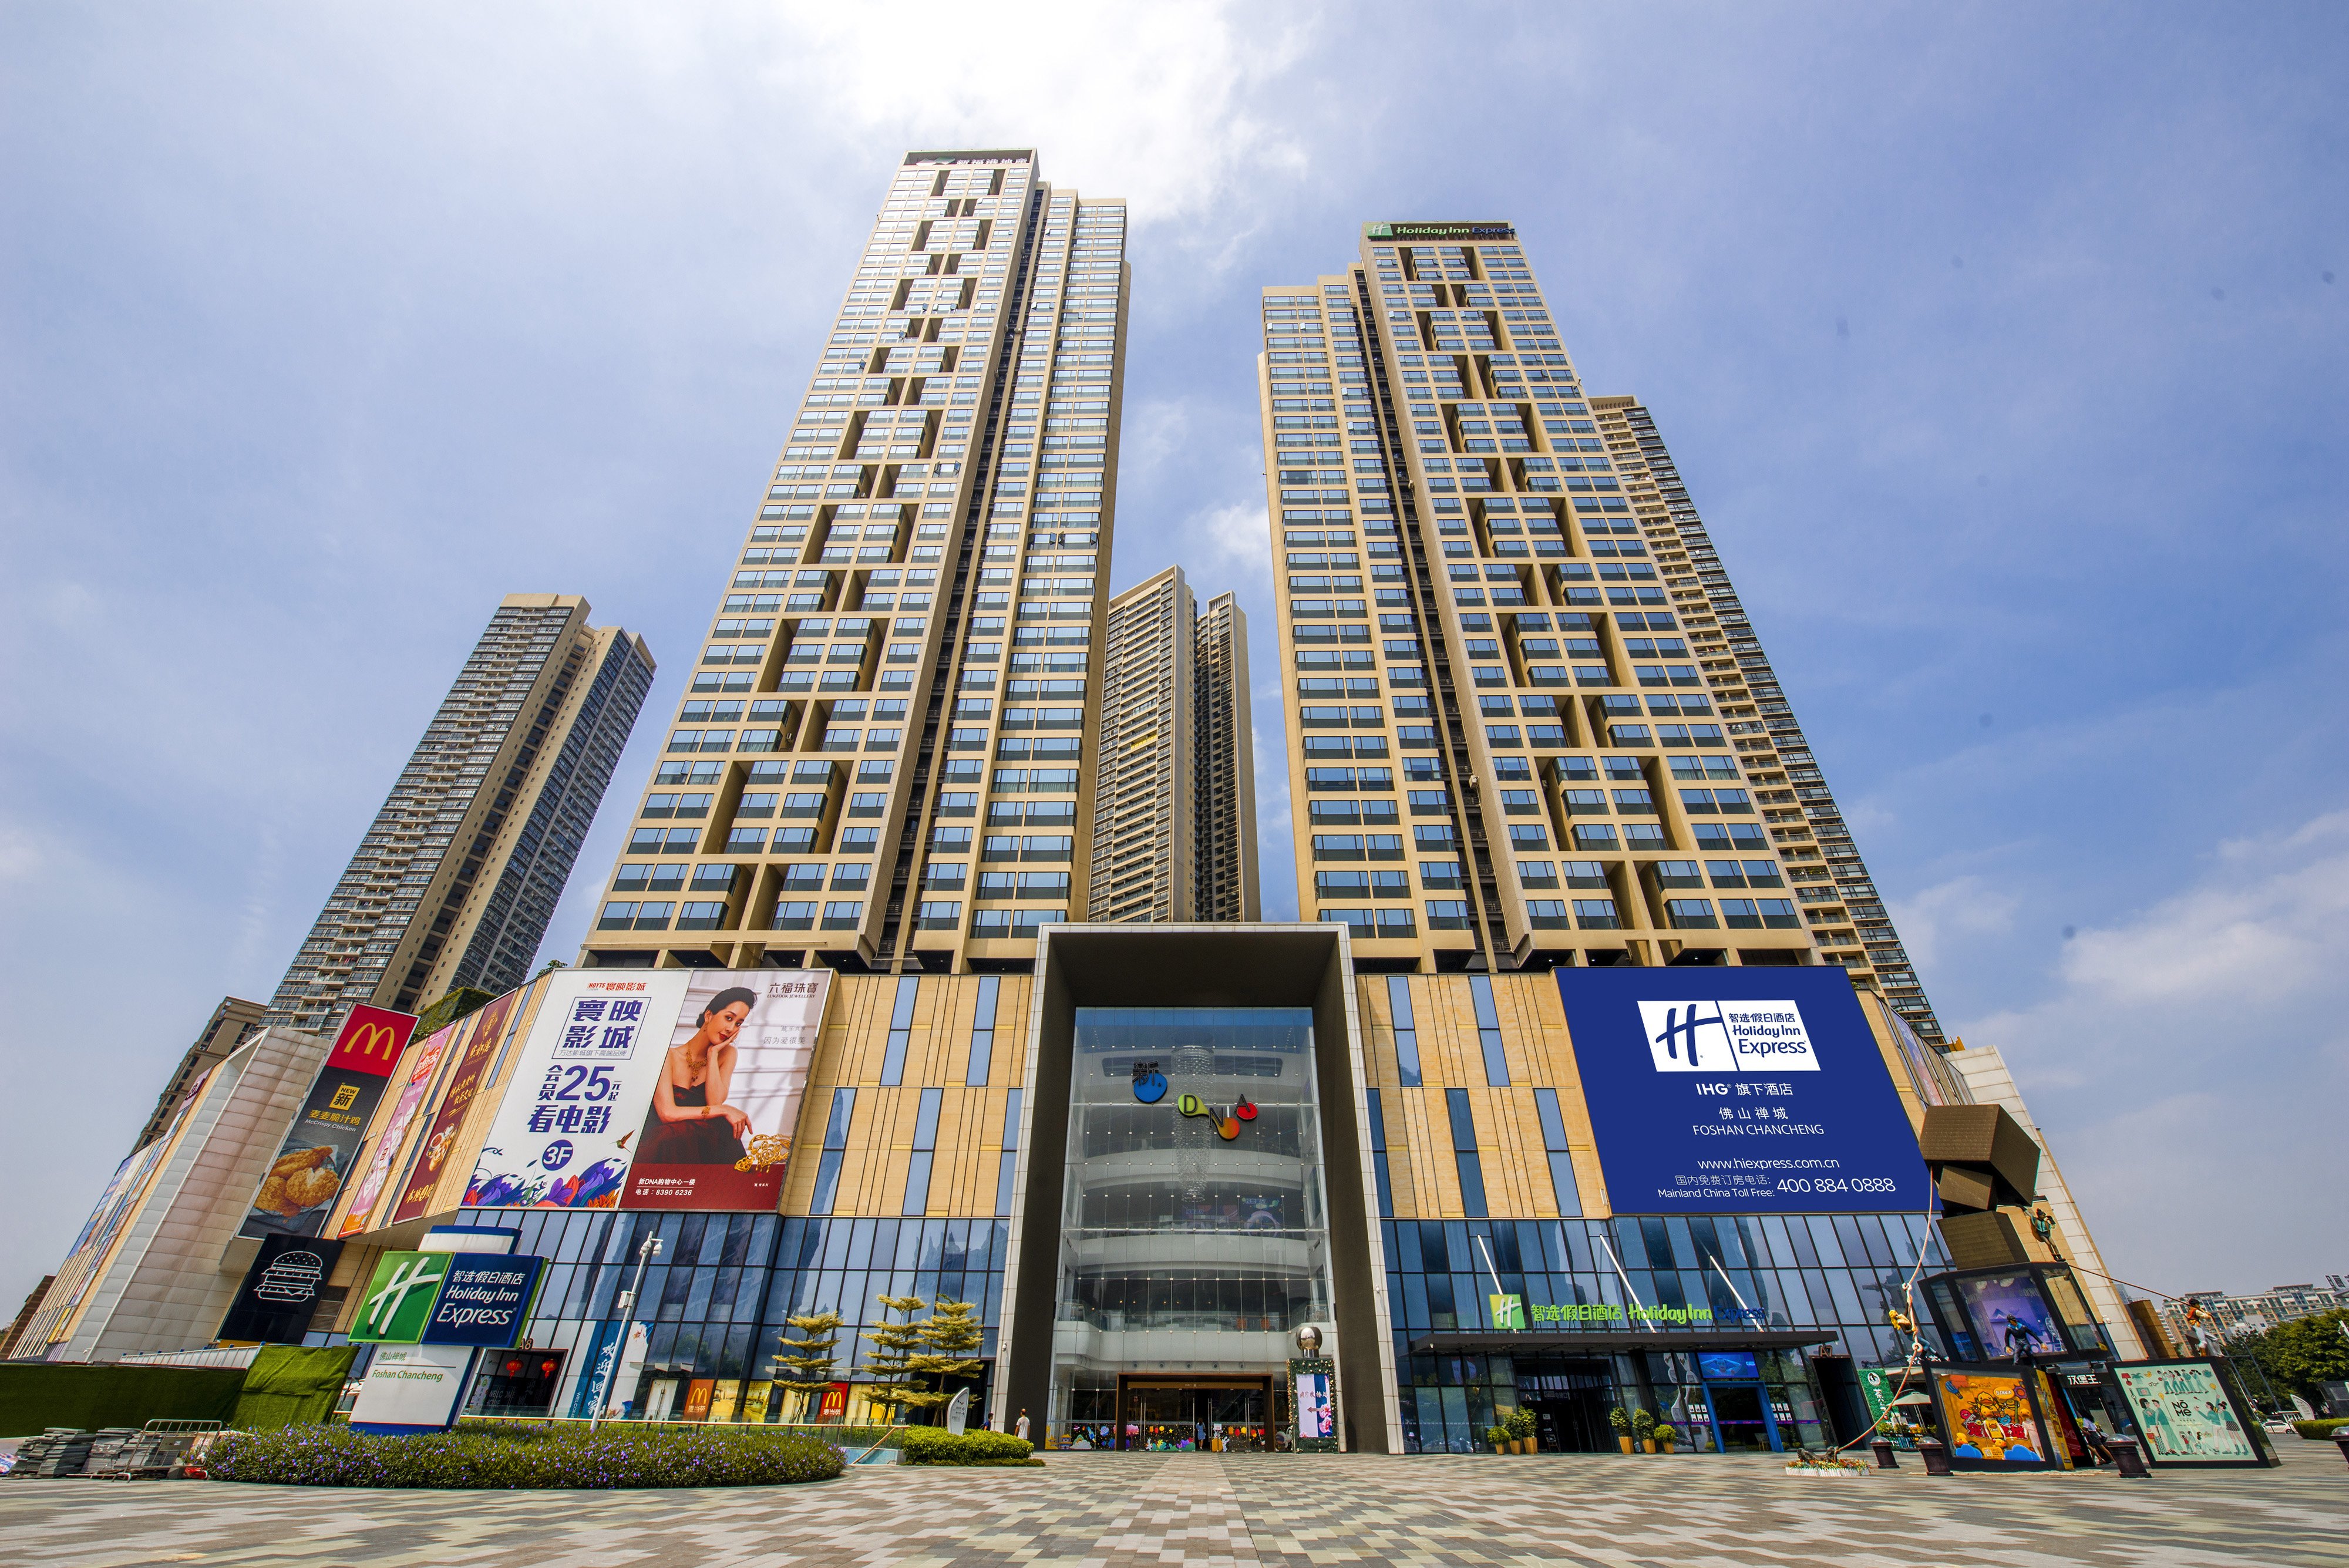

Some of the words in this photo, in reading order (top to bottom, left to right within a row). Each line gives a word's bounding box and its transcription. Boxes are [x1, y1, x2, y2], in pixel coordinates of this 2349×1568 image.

[1396, 227, 1447, 235] Holiday
[769, 982, 819, 994] 六福珠寶
[1728, 1012, 1796, 1024] 智选假日酒店
[562, 1025, 635, 1048] 影城
[1732, 1024, 1781, 1038] Holiday
[1782, 1025, 1801, 1035] Inn
[763, 1036, 806, 1045] 因为爱很美
[1738, 1038, 1808, 1058] Express
[1132, 1059, 1159, 1086] 新
[555, 1065, 615, 1101] 25
[1696, 1084, 1728, 1096] IHG
[1735, 1083, 1793, 1096] 旗下酒店
[332, 1093, 354, 1107] 新
[308, 1109, 361, 1126] 麦麦脆汁鸡
[527, 1105, 613, 1133] 看电影
[1718, 1107, 1788, 1121] 佛山禅城
[305, 1119, 332, 1128] McCrispy
[332, 1123, 356, 1132] Chicken
[1692, 1125, 1744, 1136] FOSHAN
[1746, 1124, 1825, 1135] CHANCHENG
[543, 1146, 574, 1165] 3F
[1697, 1158, 1840, 1172] www.hiexpress.com.cn
[638, 1177, 696, 1186] 新DNA购物中心一楼
[1777, 1178, 1810, 1193] 400
[1814, 1178, 1848, 1193] 884
[1851, 1178, 1896, 1193] 0888
[1658, 1188, 1701, 1199] Mainland
[1703, 1188, 1730, 1198] China
[1732, 1188, 1749, 1197] Toll
[1751, 1189, 1775, 1198] Free:
[452, 1268, 525, 1286] 智选假日酒店
[445, 1284, 494, 1304] Holiday
[494, 1288, 519, 1302] Inn
[436, 1303, 514, 1328] Express
[1531, 1303, 1622, 1321] 智选假日酒店
[1628, 1303, 1688, 1325] Holiday
[1688, 1303, 1712, 1321] Inn
[1713, 1305, 1764, 1323] Express
[519, 1338, 533, 1350] A8
[1819, 1345, 1833, 1358] A7
[371, 1368, 398, 1381] Foshan
[397, 1369, 444, 1383] Chancheng
